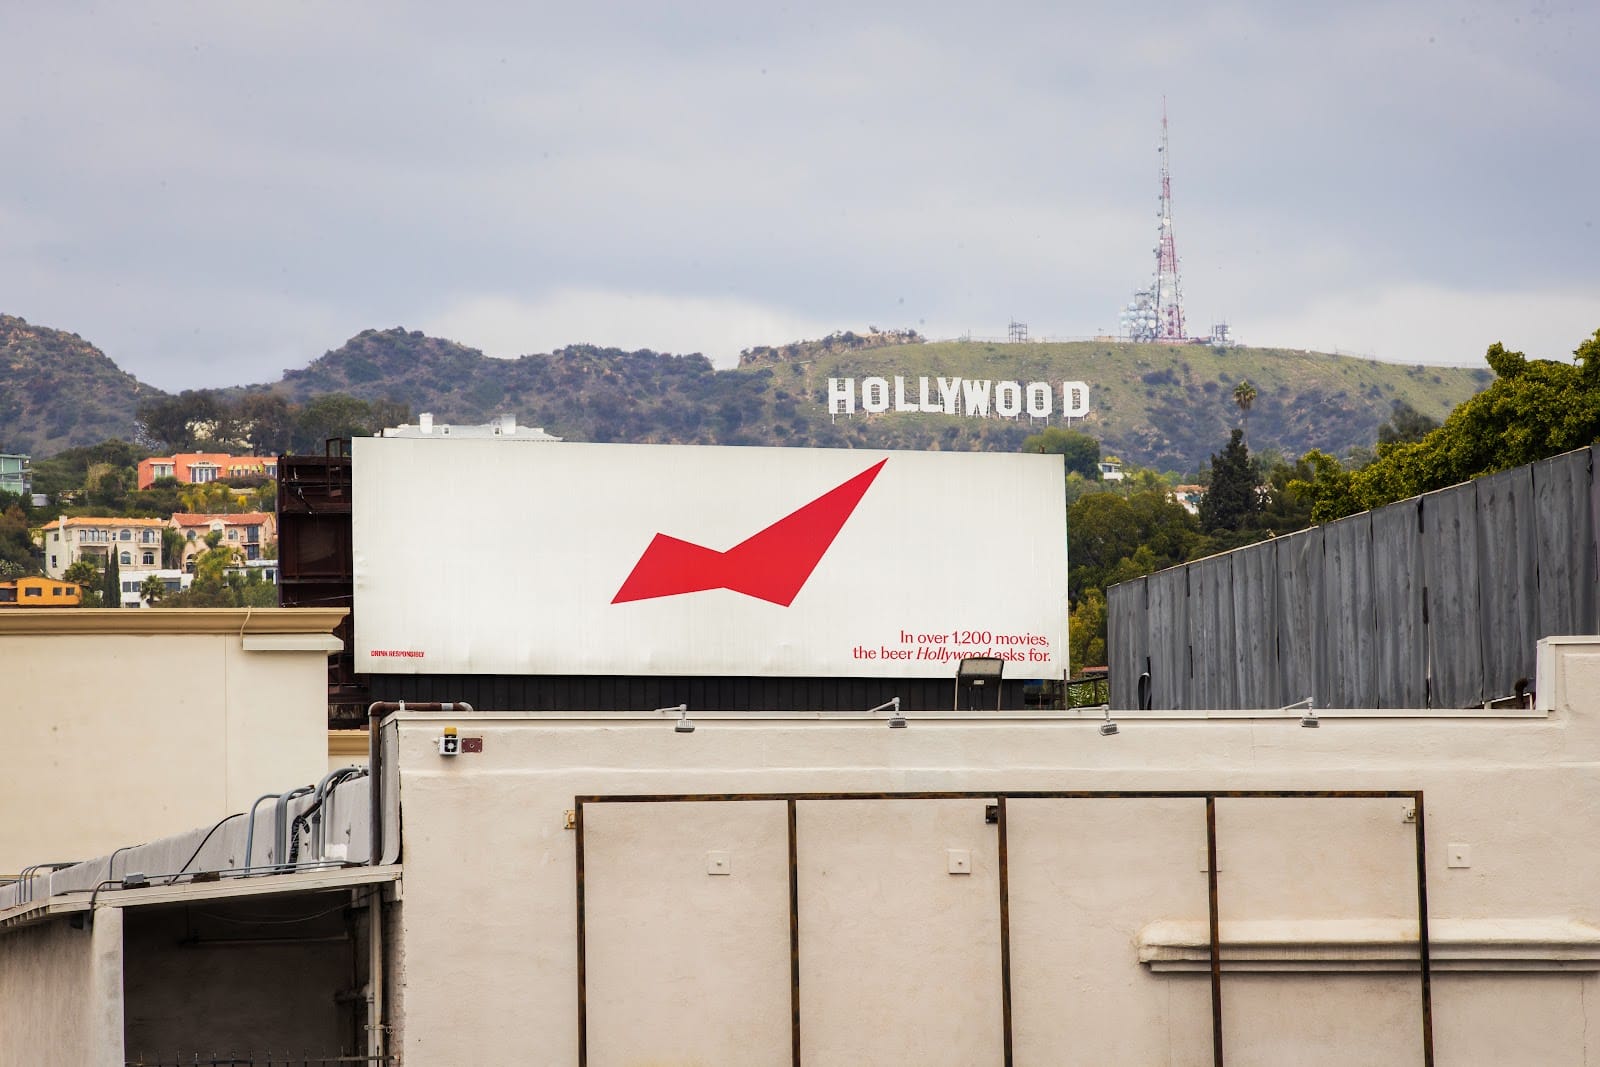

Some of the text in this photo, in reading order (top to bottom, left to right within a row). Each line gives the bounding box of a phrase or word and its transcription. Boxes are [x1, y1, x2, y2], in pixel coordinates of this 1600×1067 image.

[828, 375, 1090, 418] HOLLYWOOD
[900, 630, 1050, 648] In over 1,200 movies,
[853, 646, 1051, 664] the beer Hollywood asks for.
